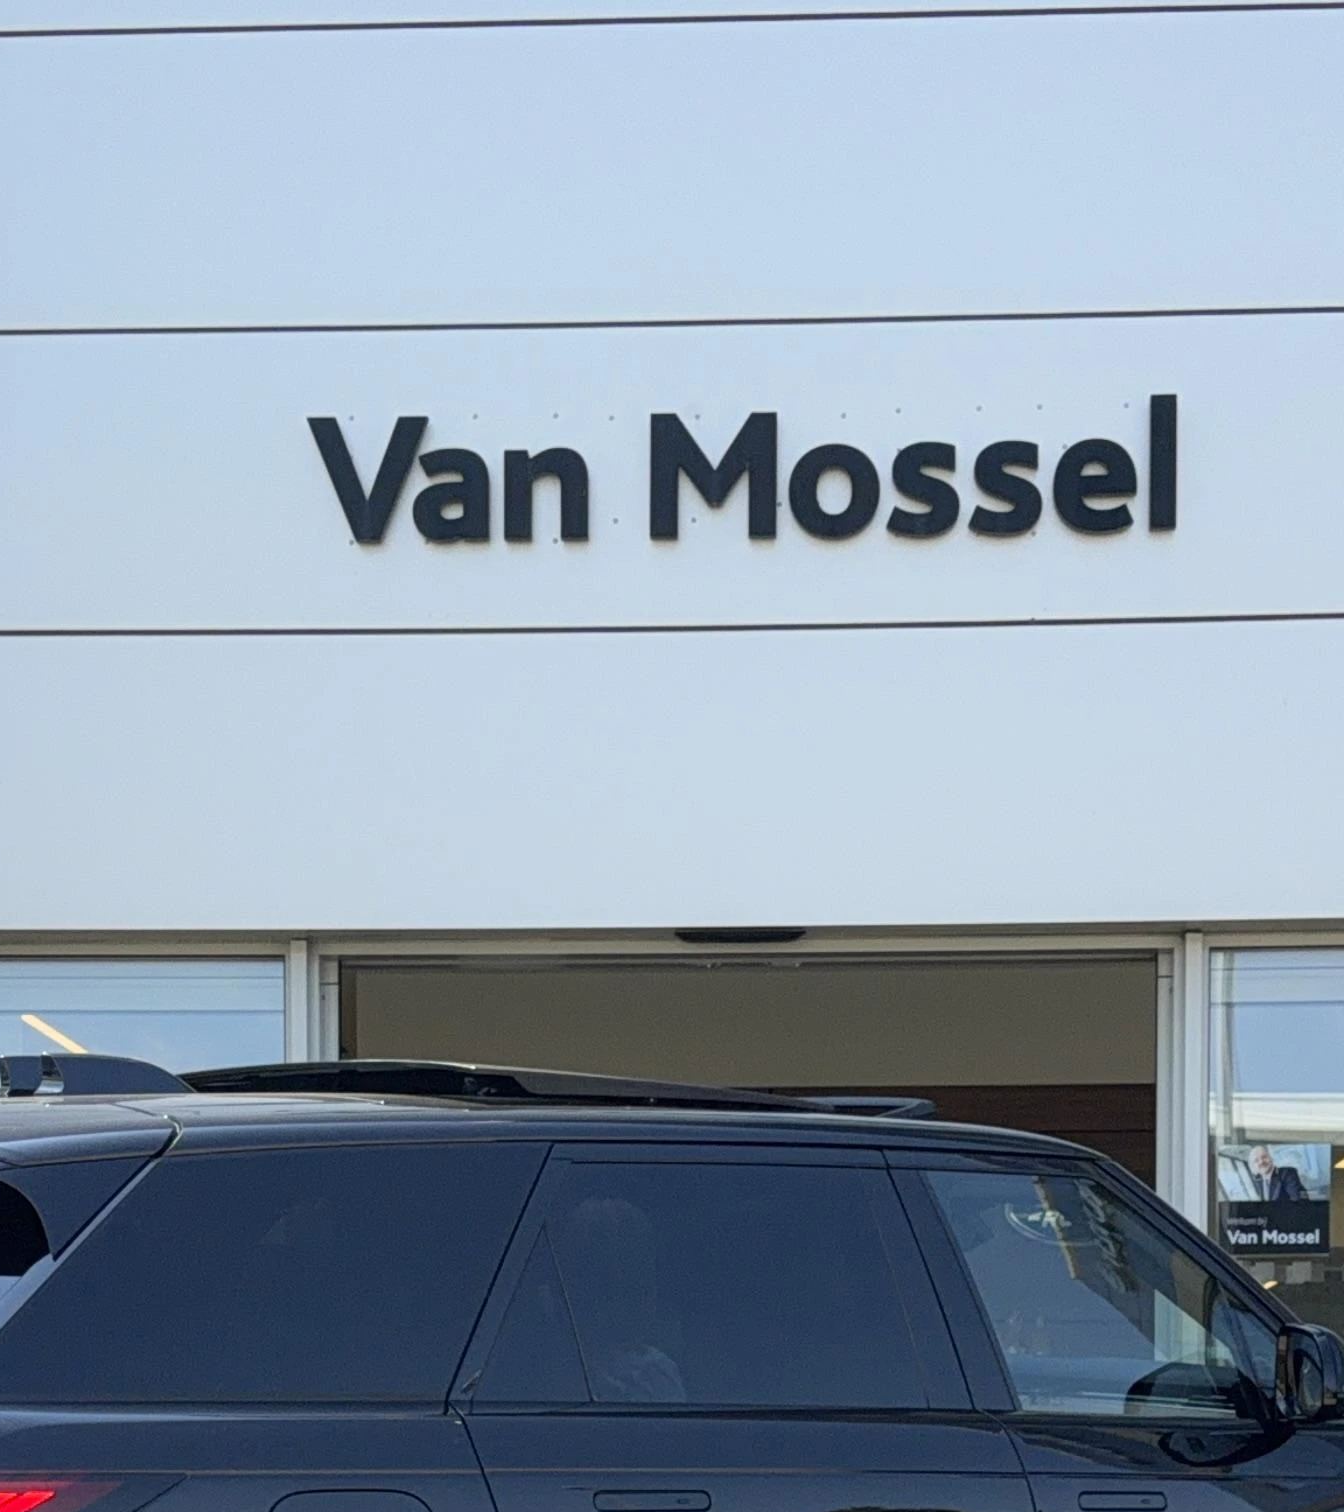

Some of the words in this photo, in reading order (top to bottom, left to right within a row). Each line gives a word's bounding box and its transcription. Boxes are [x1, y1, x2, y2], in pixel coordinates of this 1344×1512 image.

[307, 416, 590, 546] Van
[649, 393, 1178, 542] Mossel
[1226, 1228, 1258, 1246] Van
[1261, 1227, 1321, 1246] Mossel
